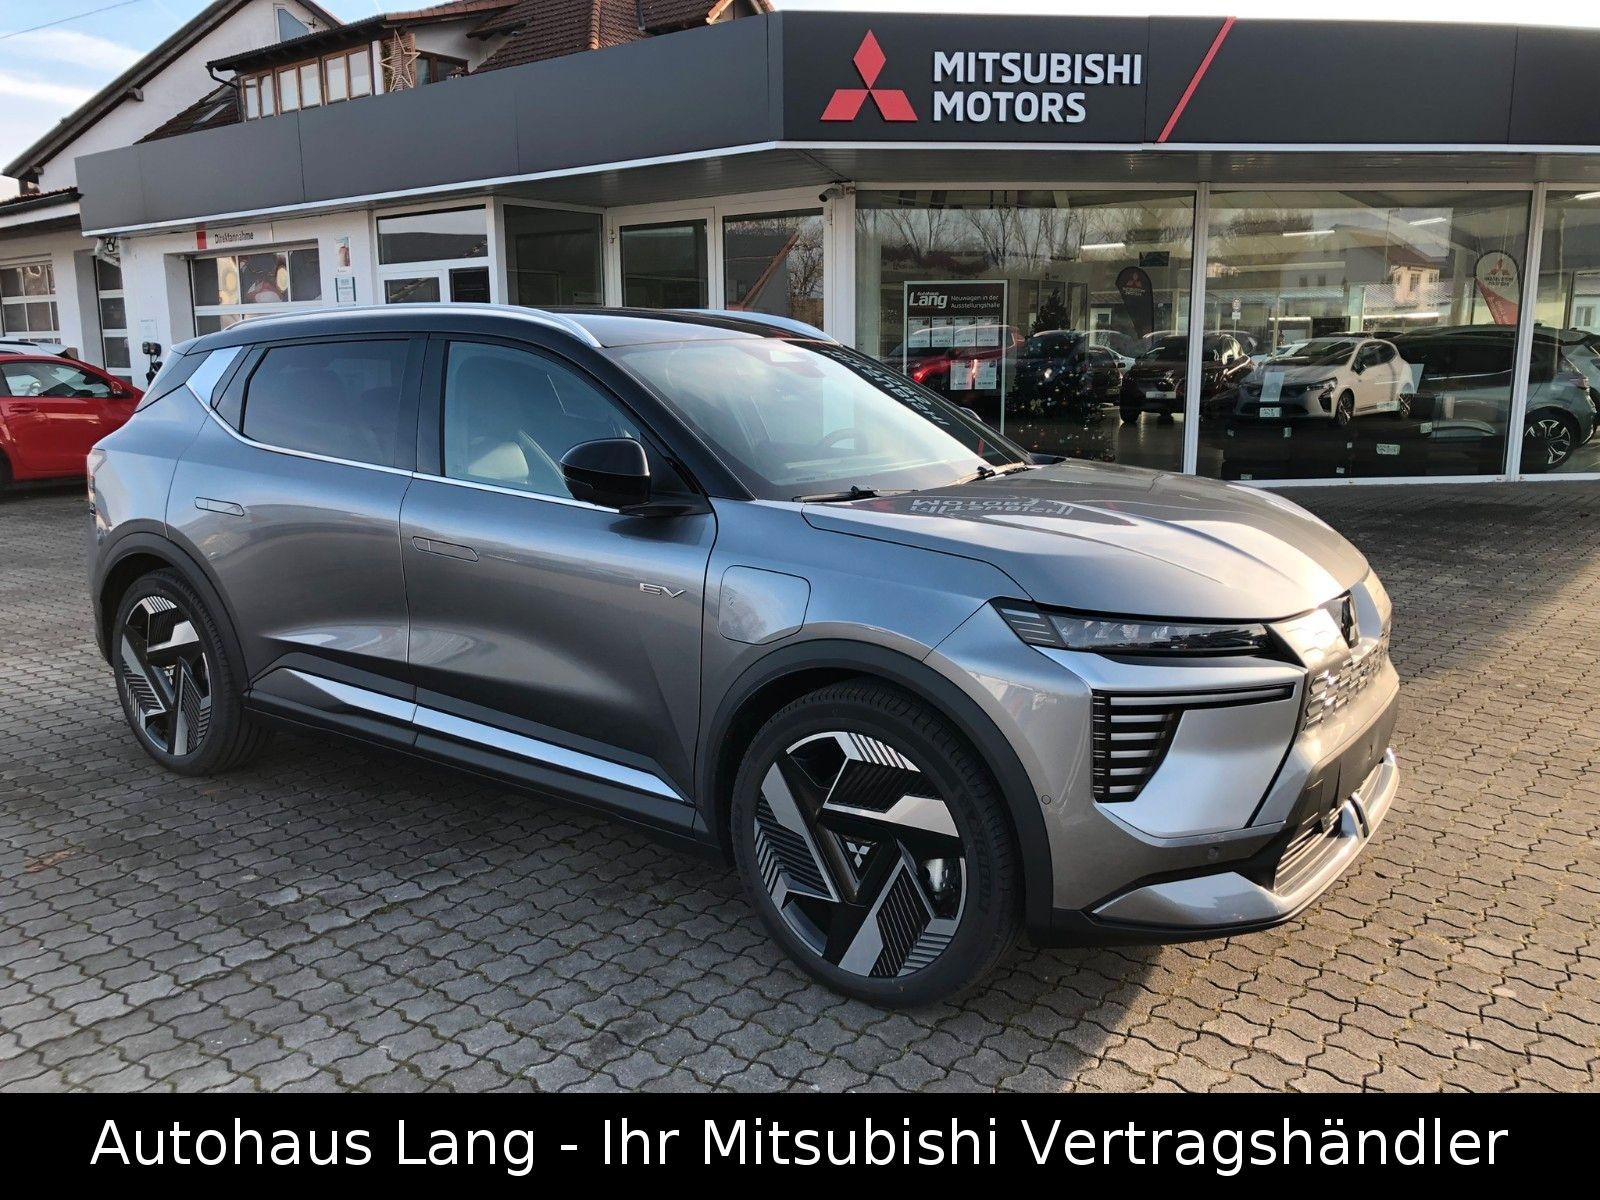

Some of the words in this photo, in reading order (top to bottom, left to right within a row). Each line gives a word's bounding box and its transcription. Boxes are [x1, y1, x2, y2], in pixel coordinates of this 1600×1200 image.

[933, 51, 1142, 85] MITSUBISHI
[933, 91, 1086, 123] MOTORS
[909, 291, 948, 309] Lang
[640, 582, 686, 598] EV
